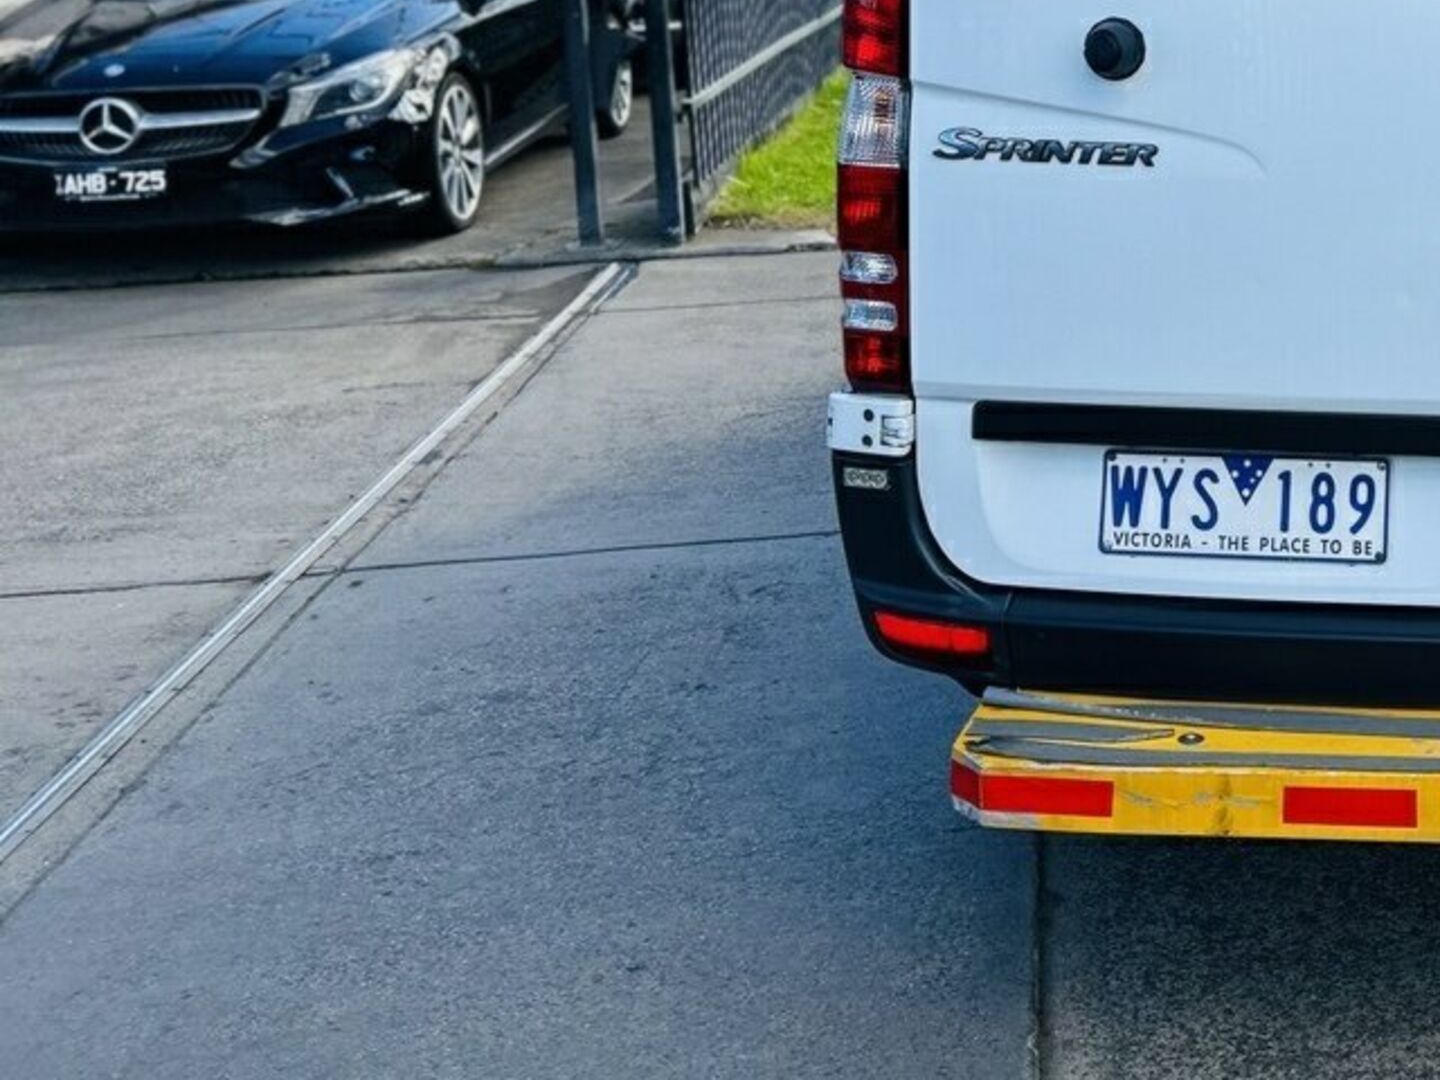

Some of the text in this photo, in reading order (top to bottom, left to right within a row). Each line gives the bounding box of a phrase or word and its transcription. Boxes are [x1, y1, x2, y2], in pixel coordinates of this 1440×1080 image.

[932, 126, 1159, 167] SPRINTER
[1110, 465, 1376, 534] WYS 189
[1113, 532, 1192, 550] VICTORIA
[1218, 535, 1250, 551] THE
[1259, 536, 1311, 554] PLACE
[1320, 538, 1342, 554] TO
[1352, 540, 1374, 555] BE
